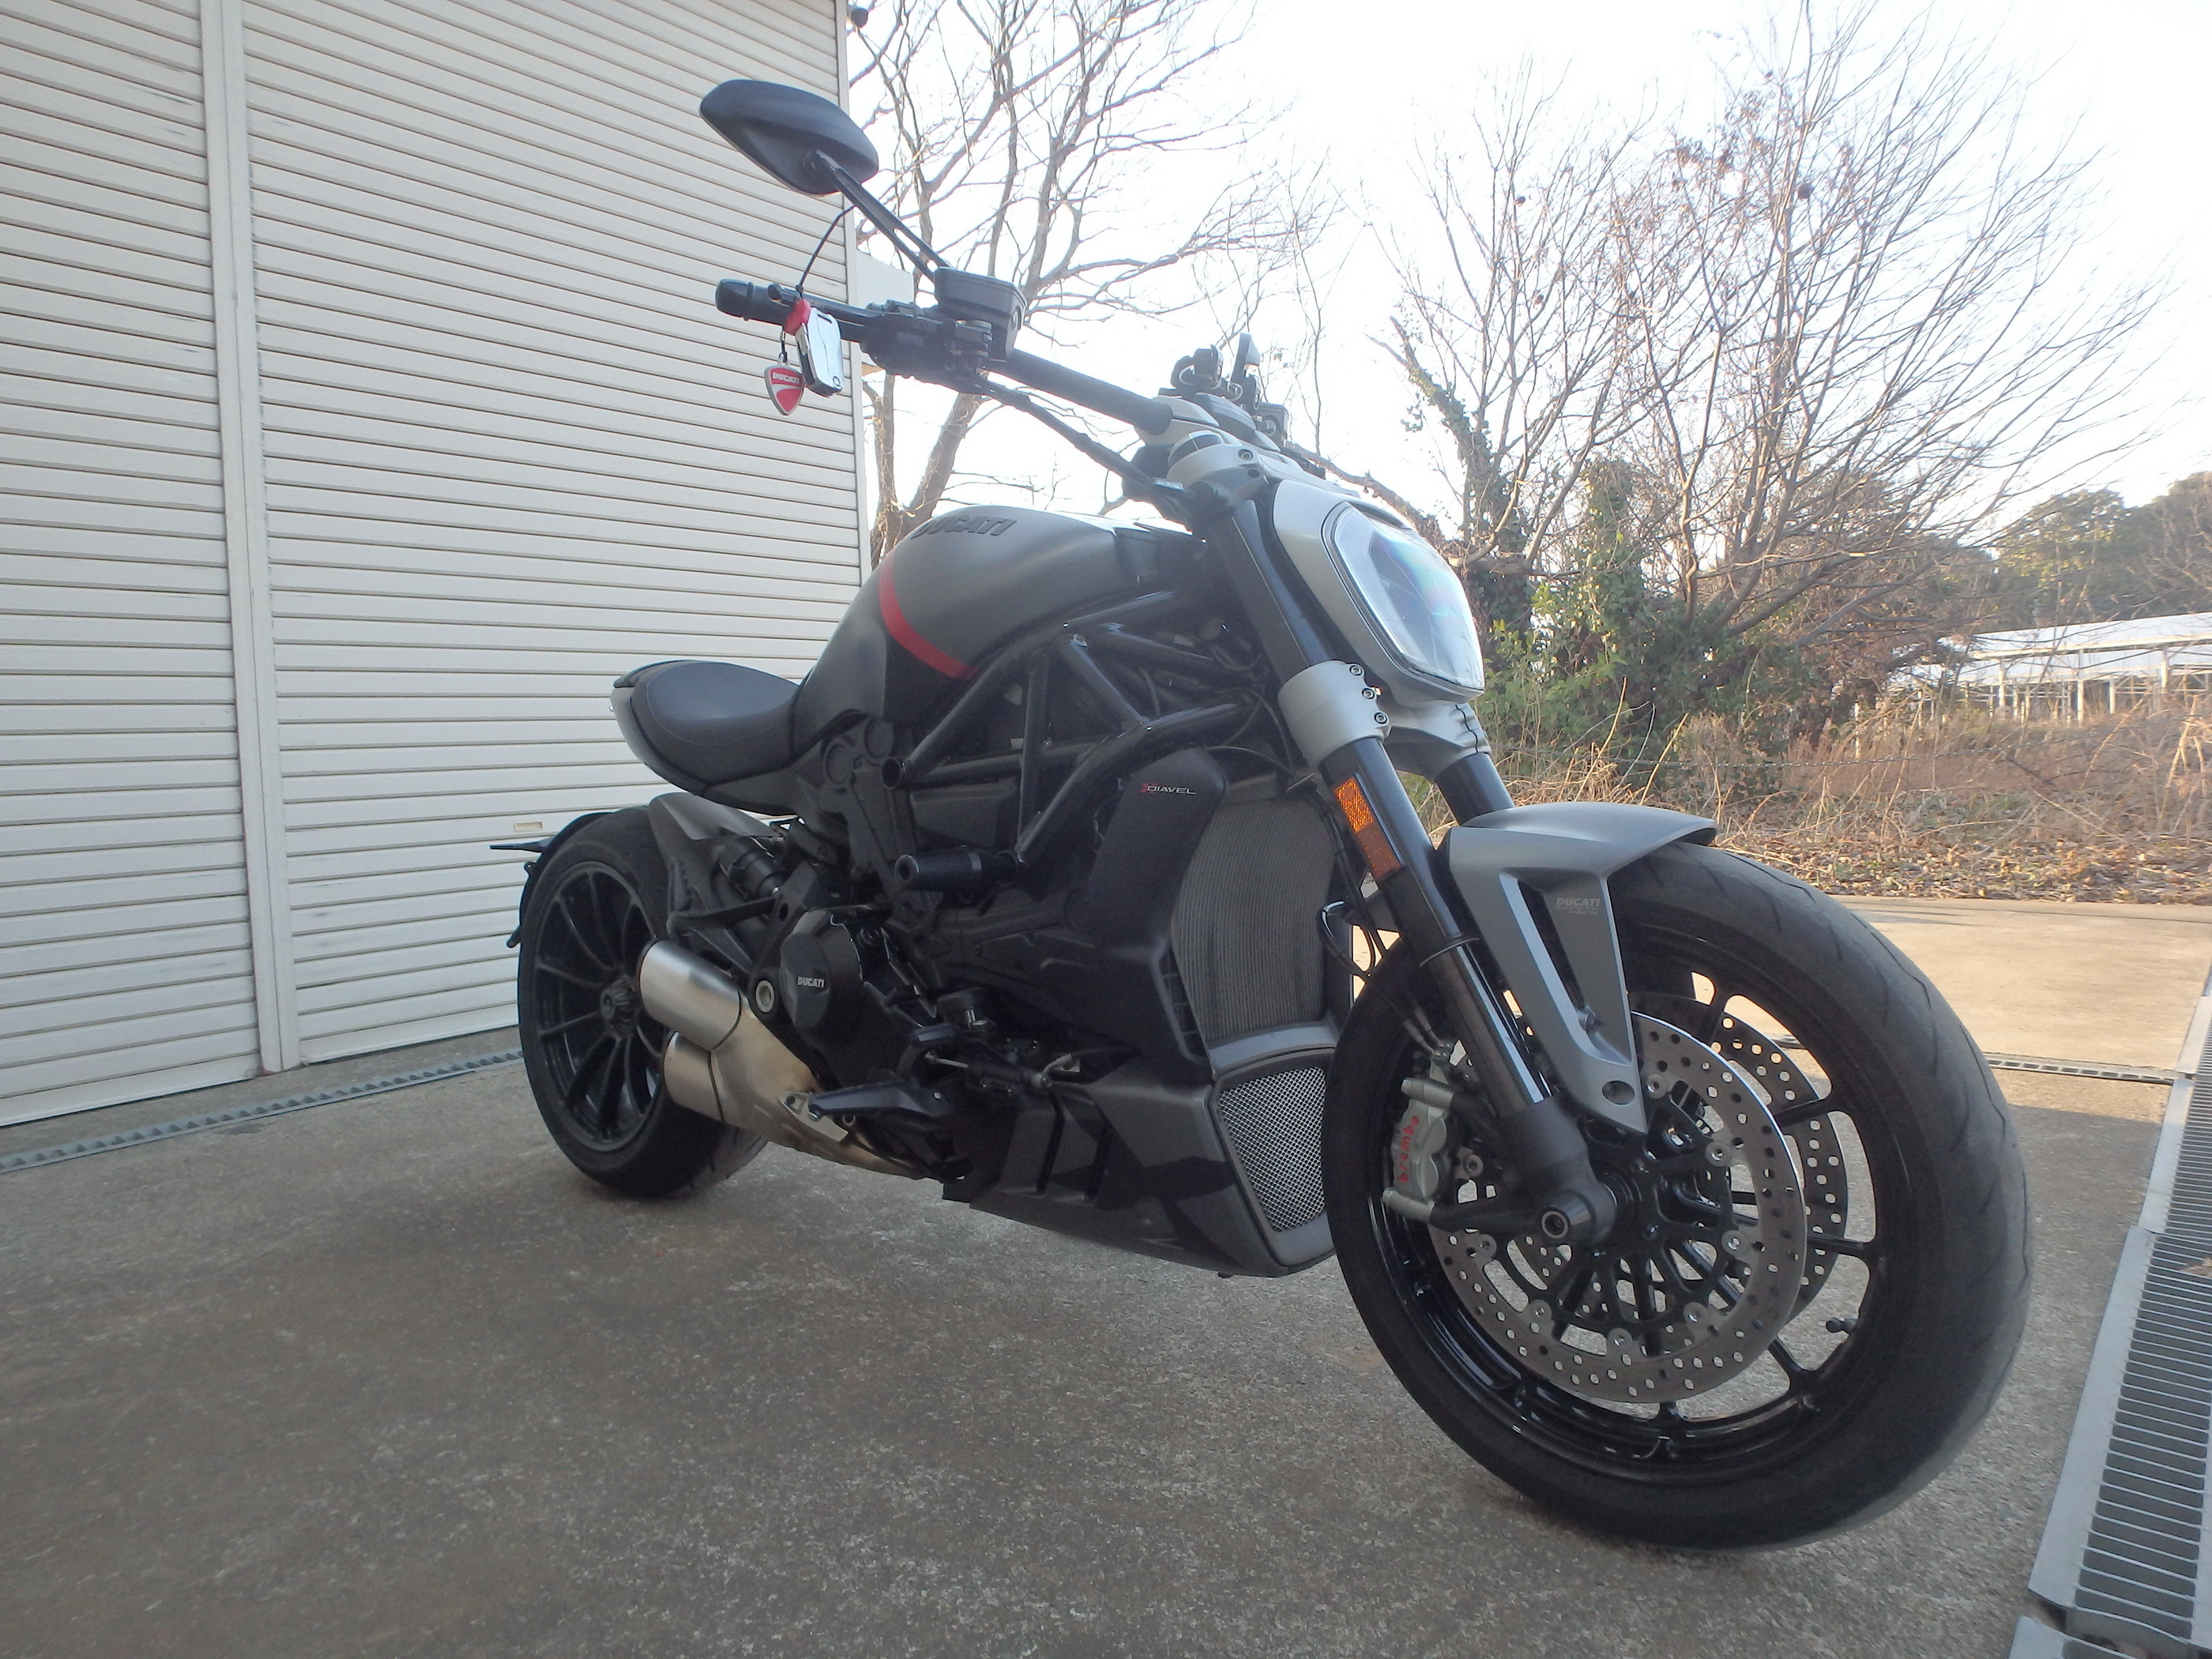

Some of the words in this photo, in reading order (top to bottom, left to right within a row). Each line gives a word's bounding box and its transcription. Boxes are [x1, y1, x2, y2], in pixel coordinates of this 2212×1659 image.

[772, 372, 800, 384] DUCATI
[911, 516, 1017, 540] DUCATI
[1555, 897, 1601, 907] DUCATI
[797, 976, 825, 988] DUCATI
[1397, 1115, 1420, 1183] brembo
